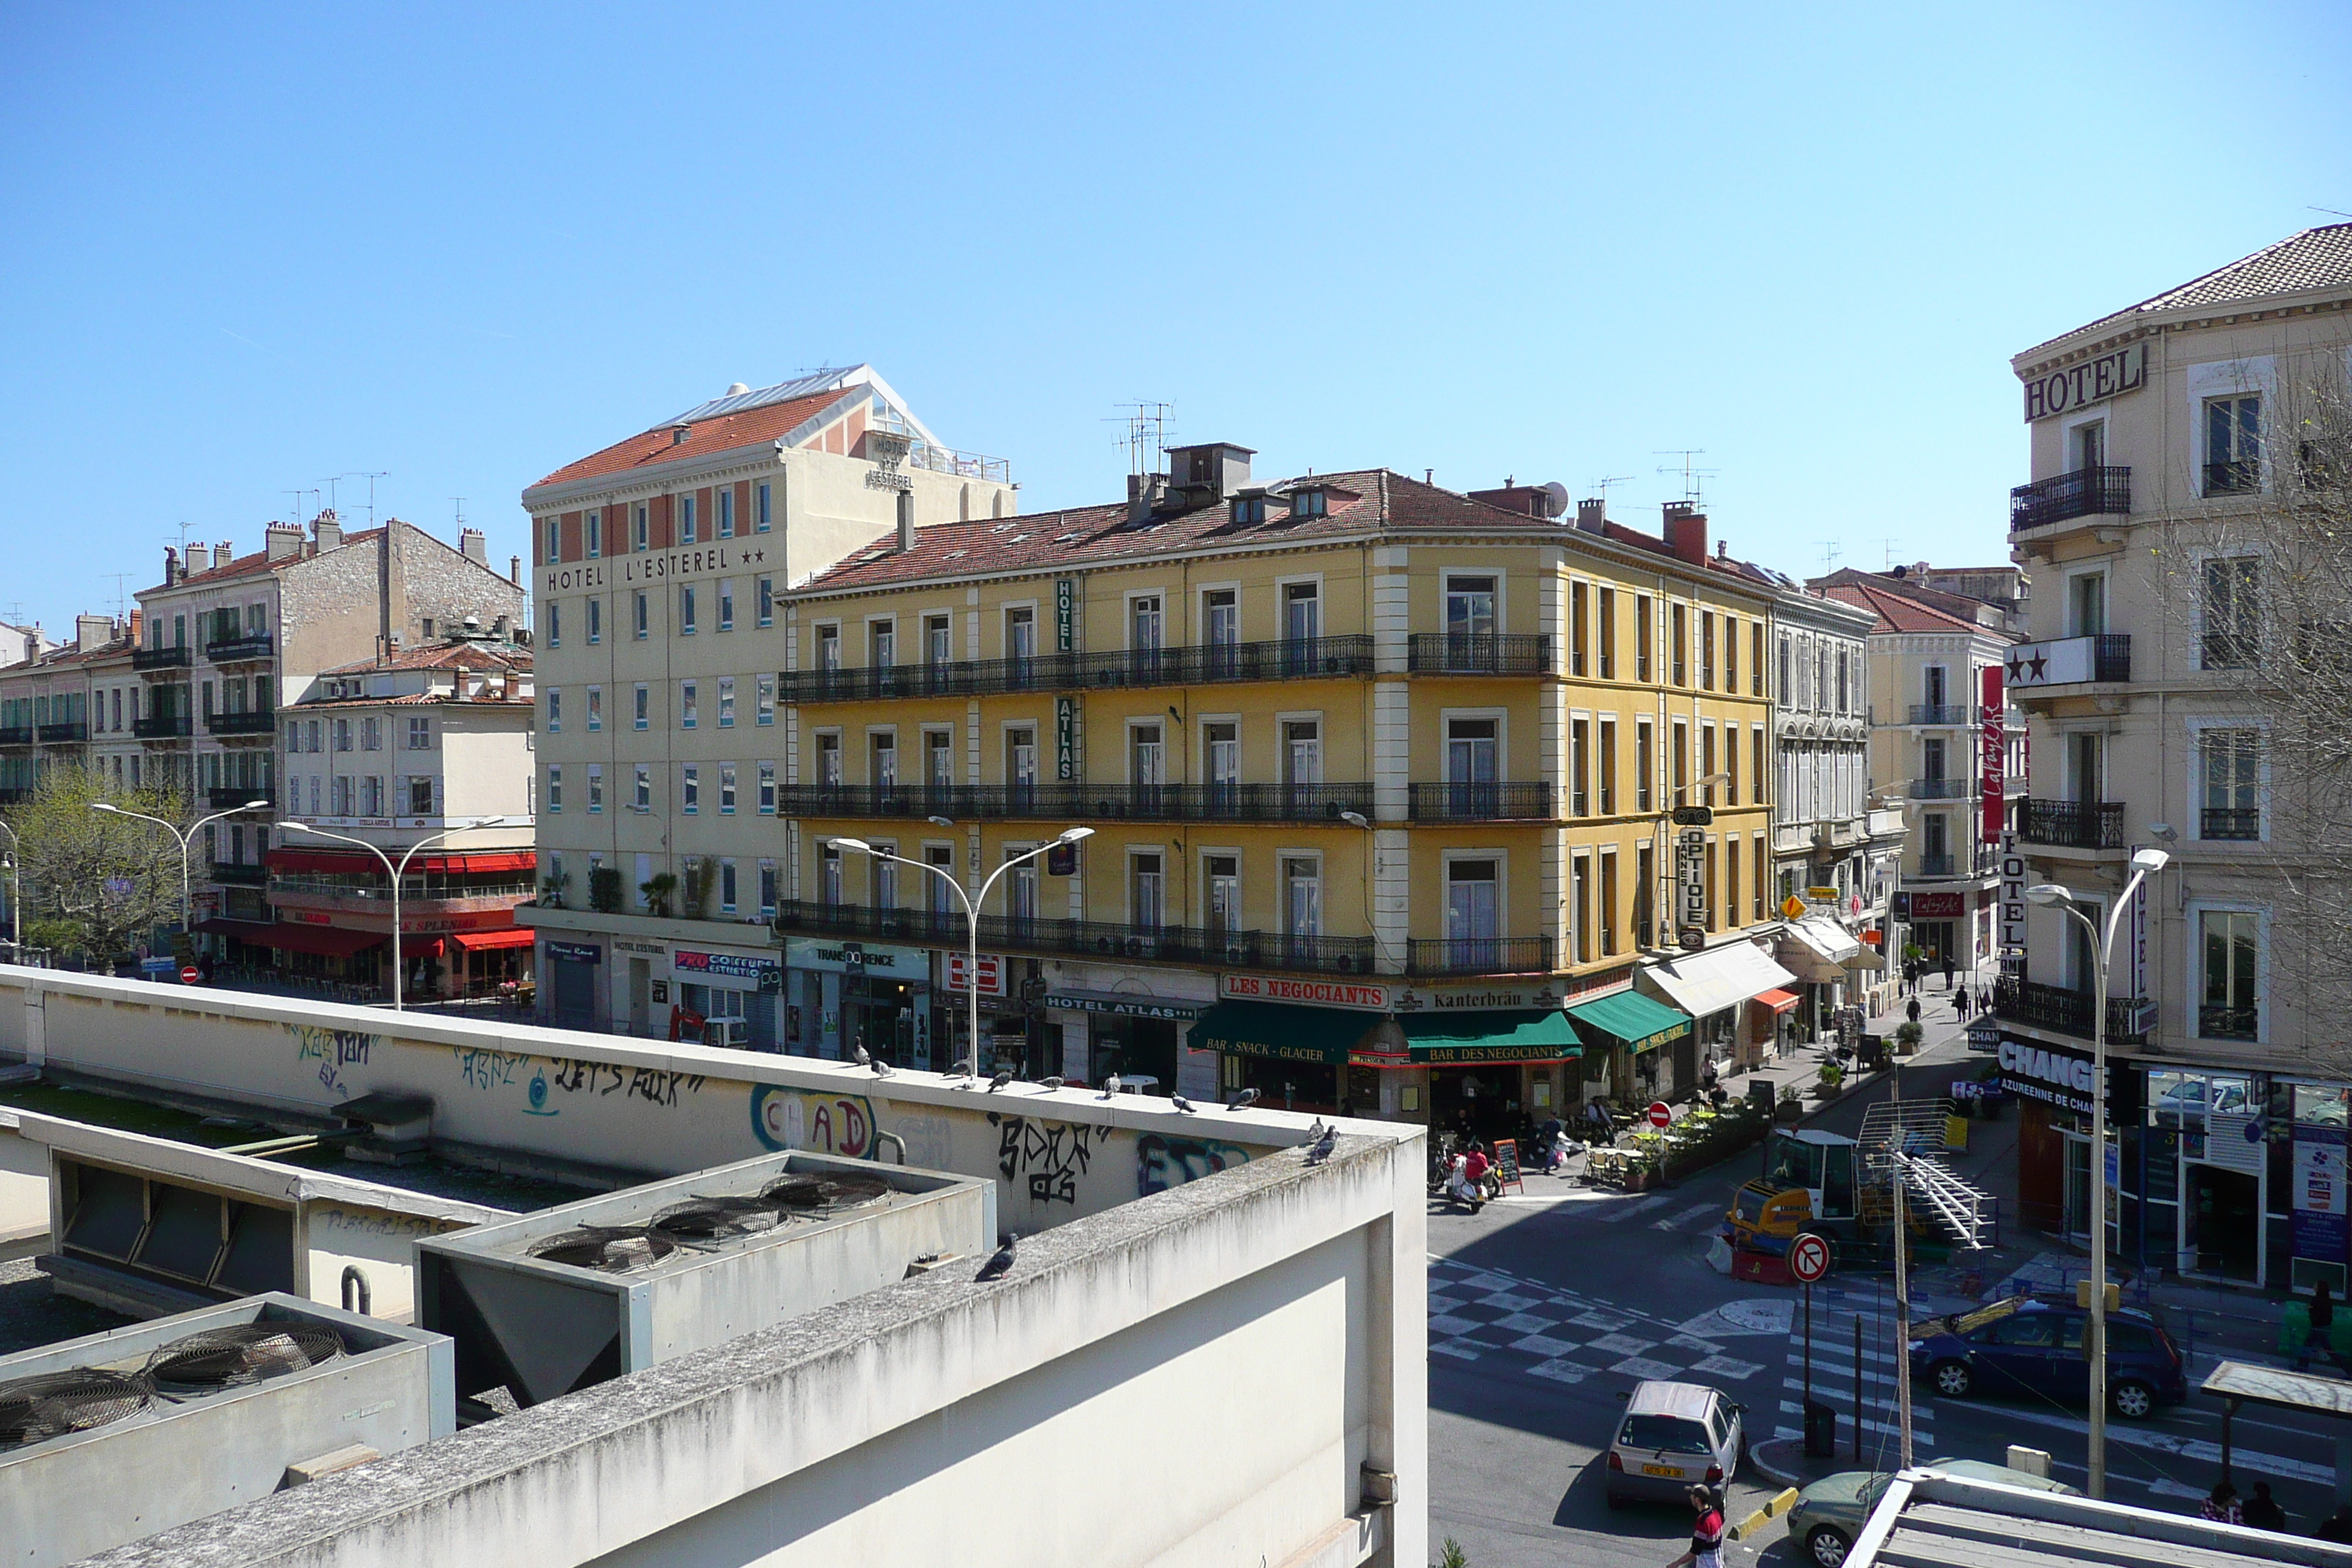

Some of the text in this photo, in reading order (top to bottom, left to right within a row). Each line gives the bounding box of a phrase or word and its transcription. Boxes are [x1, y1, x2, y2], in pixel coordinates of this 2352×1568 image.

[2024, 350, 2141, 422] HOTEL
[876, 438, 908, 456] HOTEL
[868, 469, 914, 489] L'ESTEREL
[548, 548, 728, 592] HOTEL L'ESTEREL
[1060, 582, 1070, 650] HOTEL
[1060, 700, 1071, 779] ATLAS
[1680, 835, 1688, 887] CANNES
[1687, 831, 1704, 923] OPTIQUE
[614, 941, 634, 951] HOTEL
[1229, 977, 1382, 1006] LES NEGOCIANTS
[1434, 990, 1522, 1008] Kanterbräu
[1047, 997, 1175, 1019] HOTEL ATLAS
[1206, 1038, 1324, 1061] BAR SNACK GLACIER
[1969, 1030, 1999, 1042] CHAN
[1430, 1046, 1564, 1060] BAR DES NEGOCIANTS
[1998, 1040, 2111, 1098] CHANGE
[2001, 1077, 2111, 1120] AZUREENNE DE CHANE
